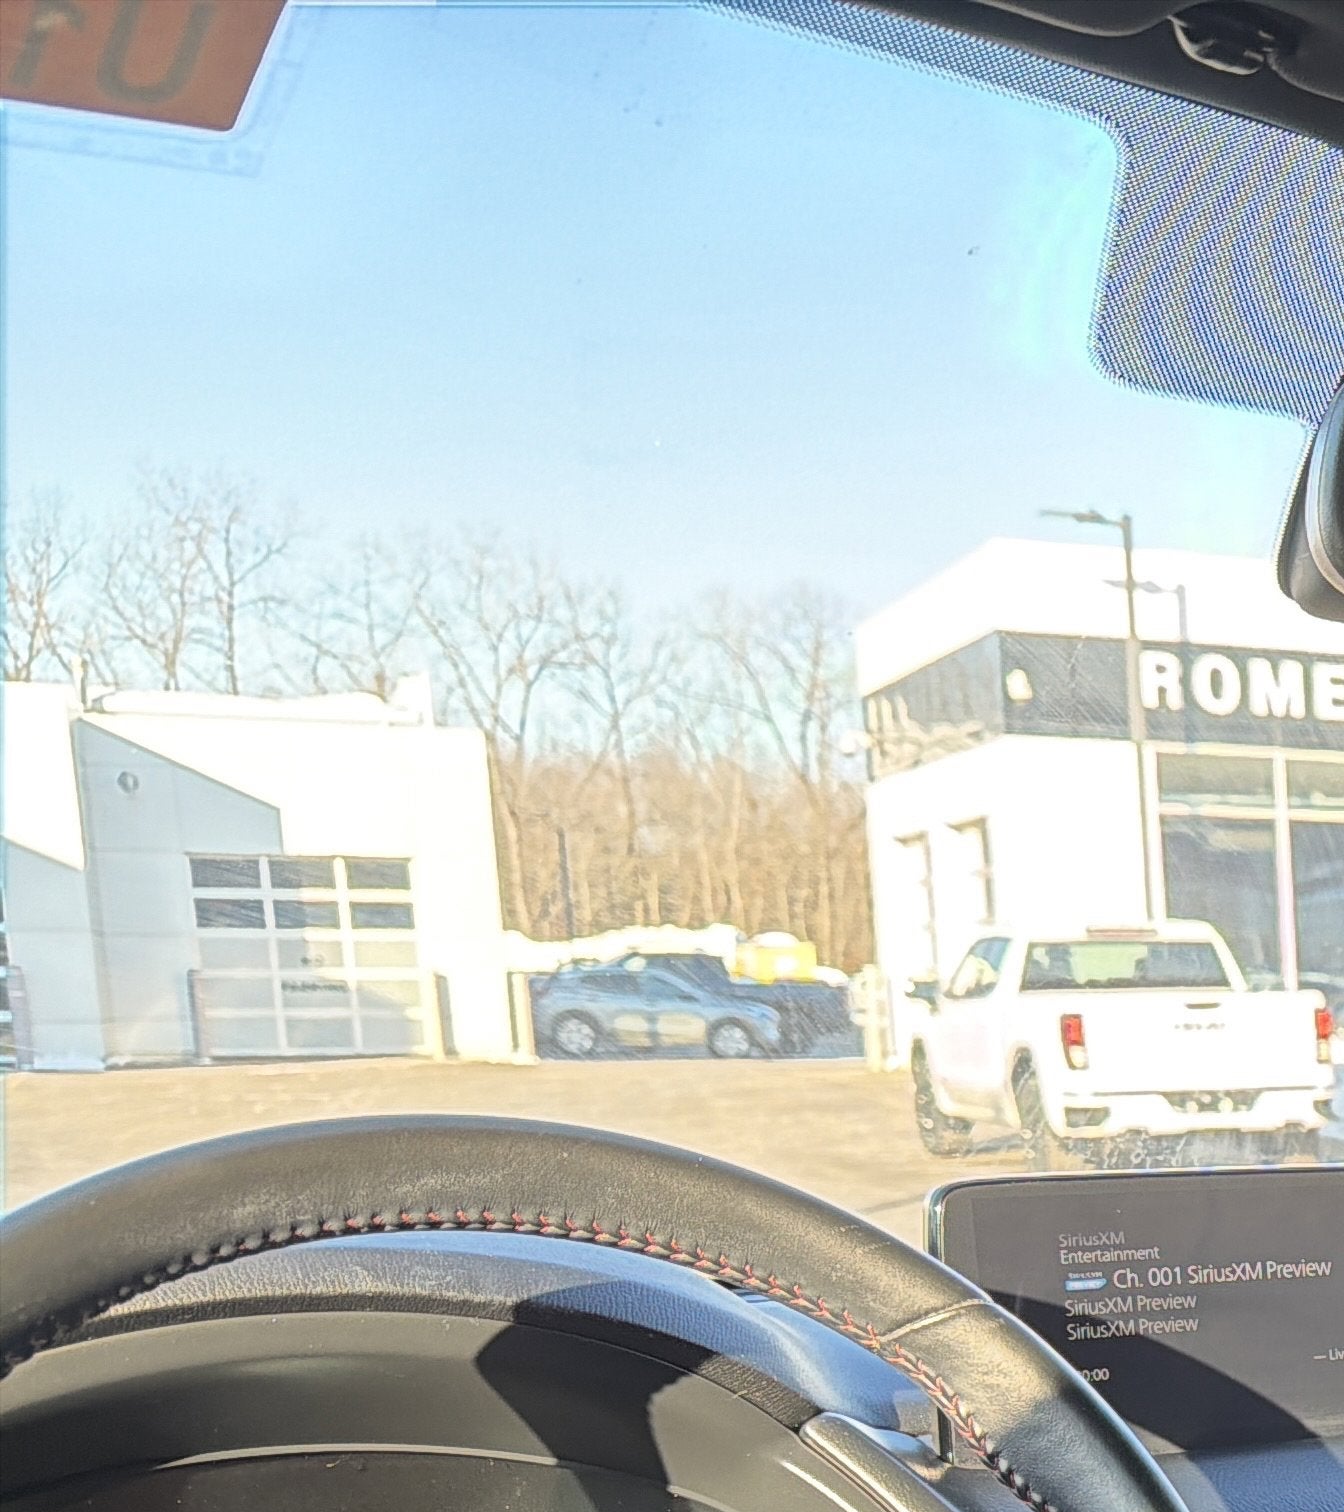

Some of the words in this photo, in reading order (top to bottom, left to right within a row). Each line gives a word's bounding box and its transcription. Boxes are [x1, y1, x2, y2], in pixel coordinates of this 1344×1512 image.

[1058, 1231, 1126, 1248] SiriusXM
[1059, 1246, 1161, 1265] Entertainment
[1113, 1267, 1145, 1289] Ch.
[1148, 1266, 1182, 1287] 001
[1187, 1260, 1263, 1285] SiriusXM
[1265, 1258, 1332, 1280] Preview
[1064, 1295, 1134, 1317] SiriusXM
[1136, 1293, 1197, 1312] Preview
[1066, 1320, 1136, 1341] SiriusXM
[1138, 1316, 1199, 1335] Preview
